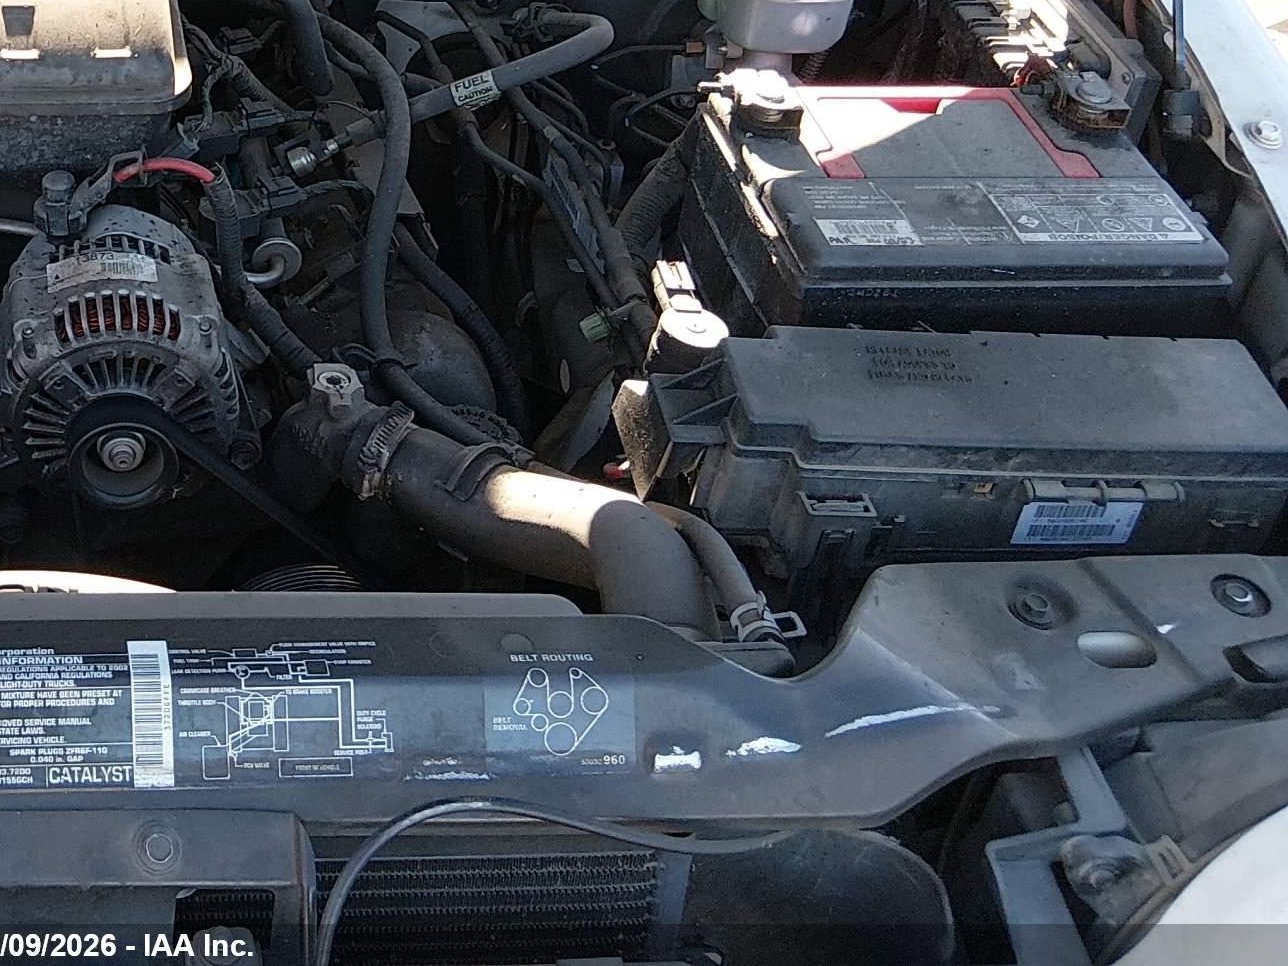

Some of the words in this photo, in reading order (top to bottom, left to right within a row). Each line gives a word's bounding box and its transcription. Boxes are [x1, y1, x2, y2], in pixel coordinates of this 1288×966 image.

[455, 75, 489, 92] FUEL
[510, 654, 538, 662] BELT
[541, 653, 593, 661] ROUTING
[61, 671, 113, 679] REGULATIONS
[44, 679, 77, 688] TRUCKS.
[0, 691, 36, 699] MIXTURE
[37, 690, 58, 699] HAVE
[59, 690, 81, 698] BEEN
[82, 689, 111, 697] PRESET
[13, 699, 44, 707] PROPER
[45, 698, 96, 707] PROCEDURES
[98, 697, 115, 706] AND
[24, 718, 56, 726] SERVICE
[58, 717, 92, 725] MANUAL
[21, 727, 46, 735] LAWS.
[33, 735, 67, 744] VEHICLE.
[9, 748, 37, 756] SPARK
[38, 747, 64, 755] PLUGS
[603, 754, 626, 765] 960
[48, 765, 133, 784] CATALYST
